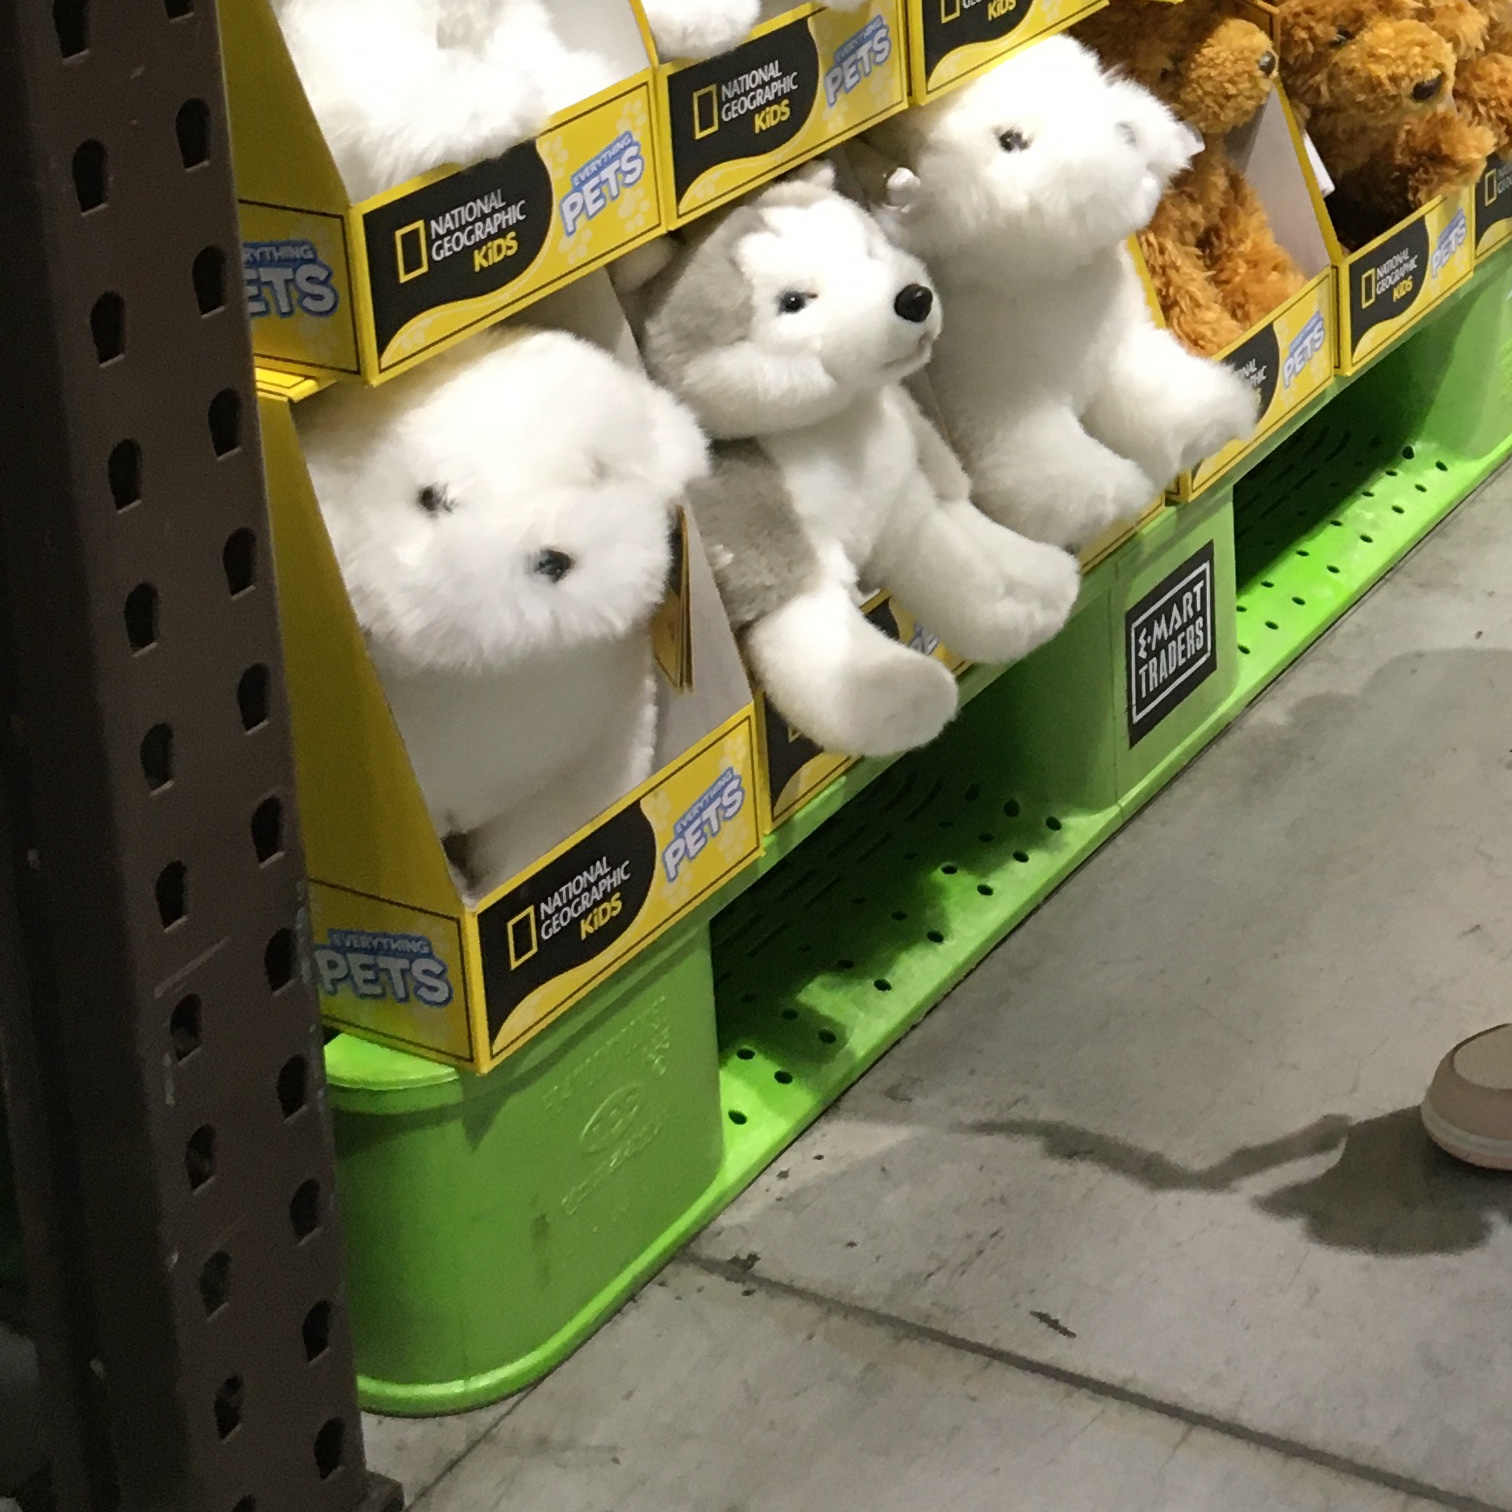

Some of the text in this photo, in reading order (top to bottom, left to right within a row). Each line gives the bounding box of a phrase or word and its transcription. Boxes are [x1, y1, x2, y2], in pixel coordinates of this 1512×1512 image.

[721, 60, 782, 101] NATIONAL
[721, 72, 798, 122] GEOGRAPHIC
[825, 26, 890, 105] PETS
[560, 146, 644, 233] PETS
[574, 132, 632, 187] EVERYTHING
[430, 189, 506, 239] NATIONAL
[431, 200, 527, 261] GEOGRAPHIC
[243, 264, 336, 315] ETS
[1283, 320, 1325, 388] PETS
[1138, 616, 1205, 699] TRADERS
[662, 779, 744, 881] PETS
[676, 769, 735, 833] EVERYTHING
[540, 856, 611, 919] NATIONAL
[541, 860, 631, 941] GEOGRAPHIC
[314, 949, 450, 1004] PETS
